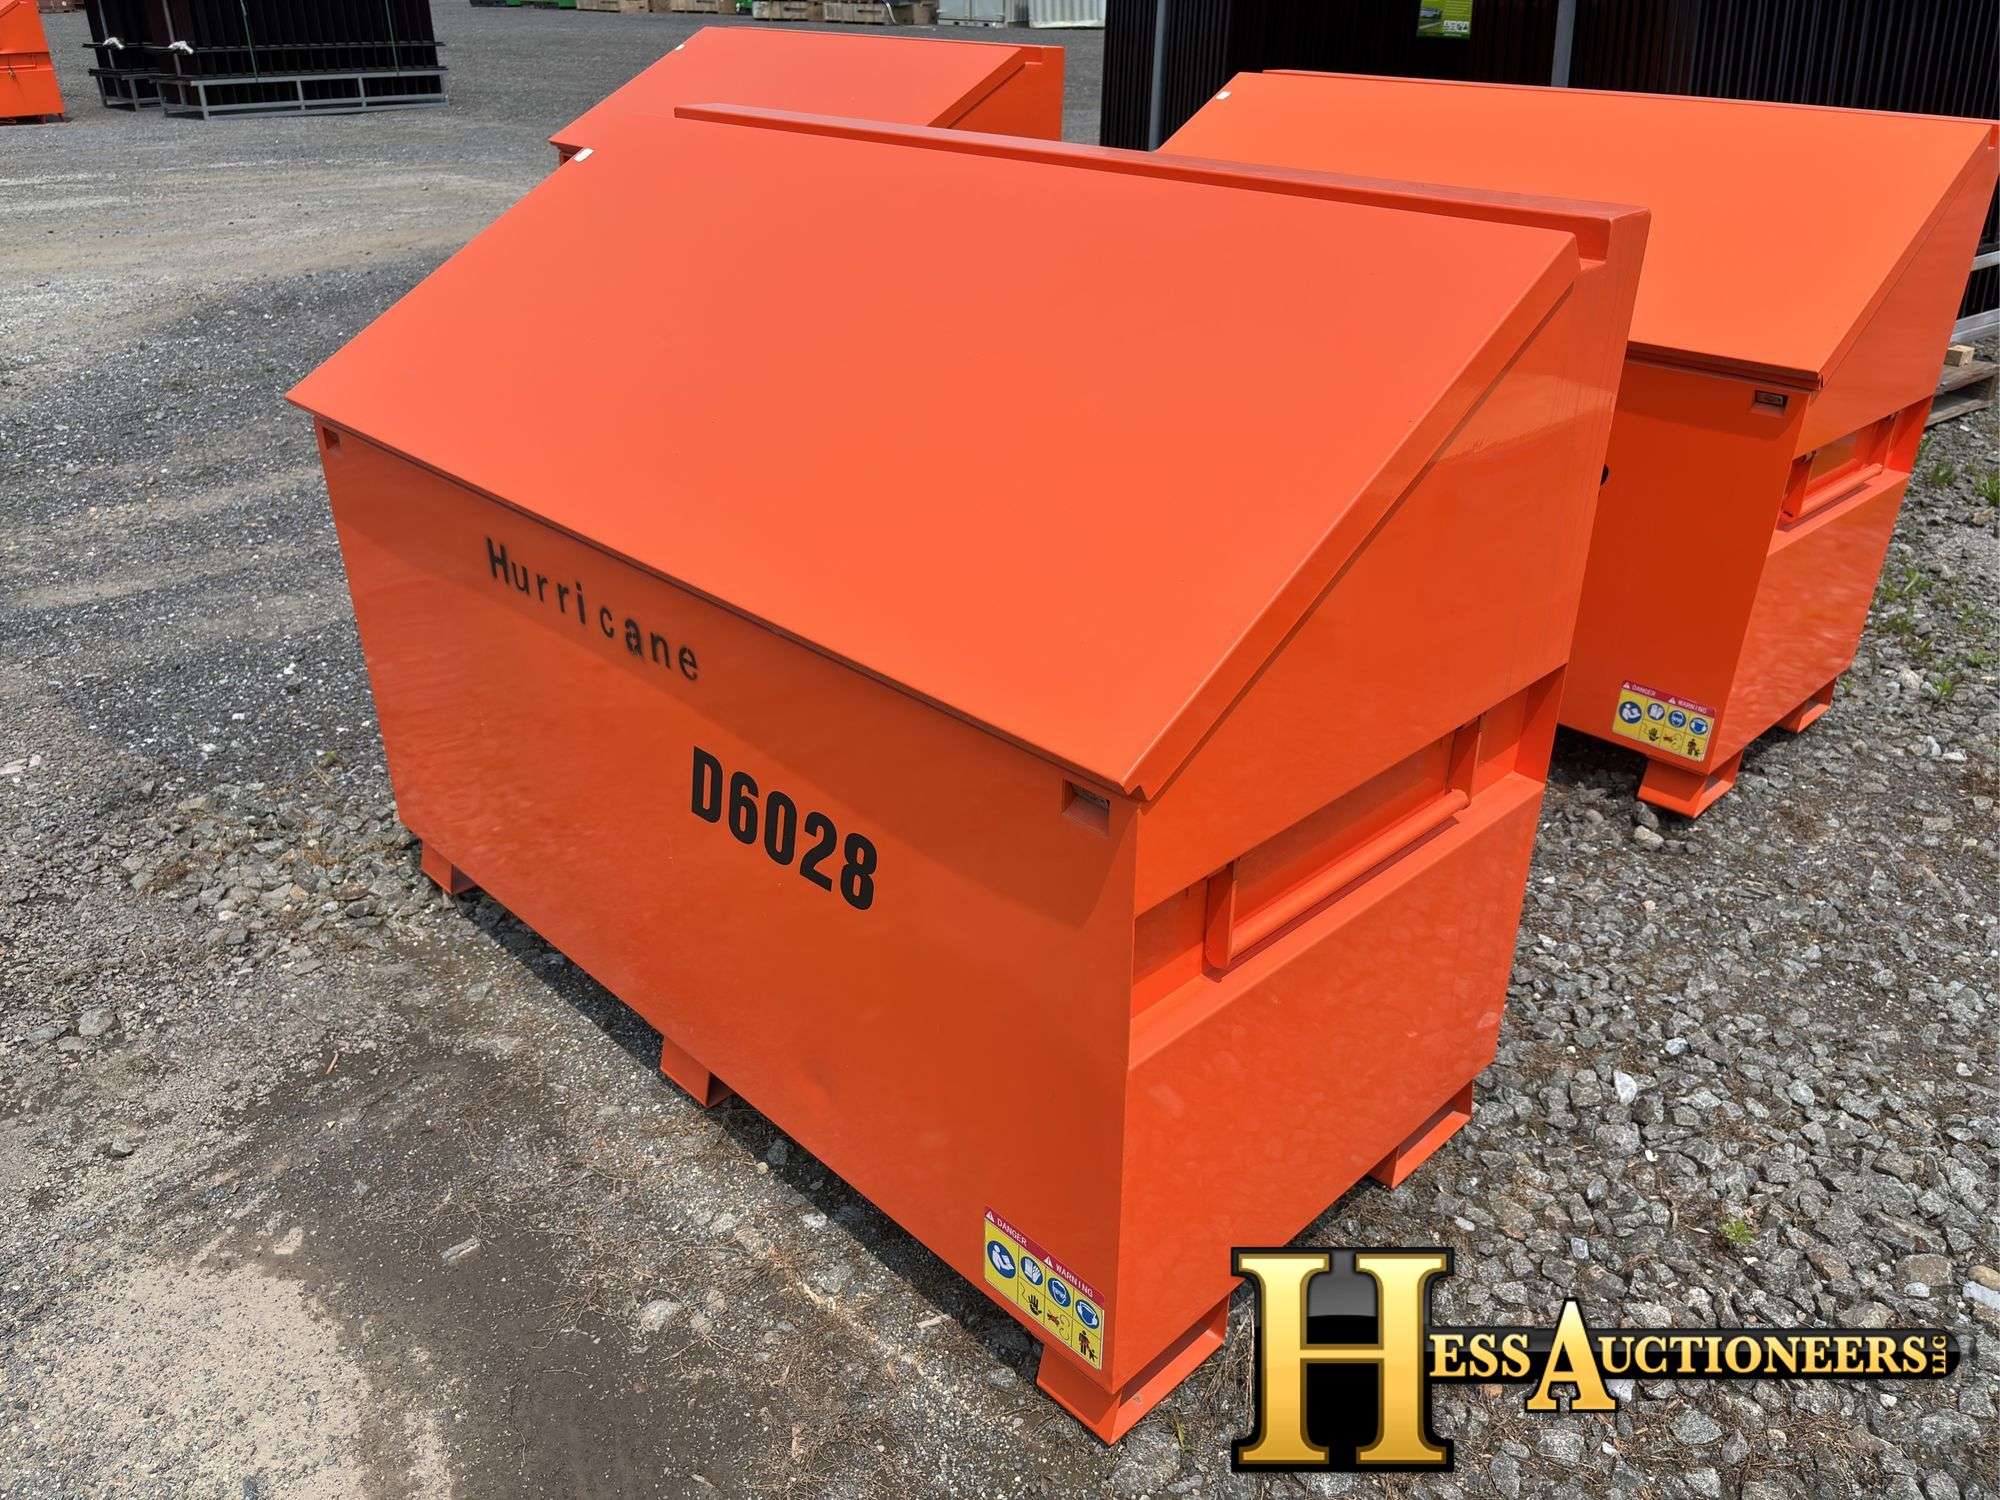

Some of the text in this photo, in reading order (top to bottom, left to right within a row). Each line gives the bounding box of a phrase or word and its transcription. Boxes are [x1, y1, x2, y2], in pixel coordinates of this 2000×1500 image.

[485, 537, 699, 681] Hurricane
[691, 745, 878, 911] D6028
[997, 1218, 1094, 1298] DANGER WARNING
